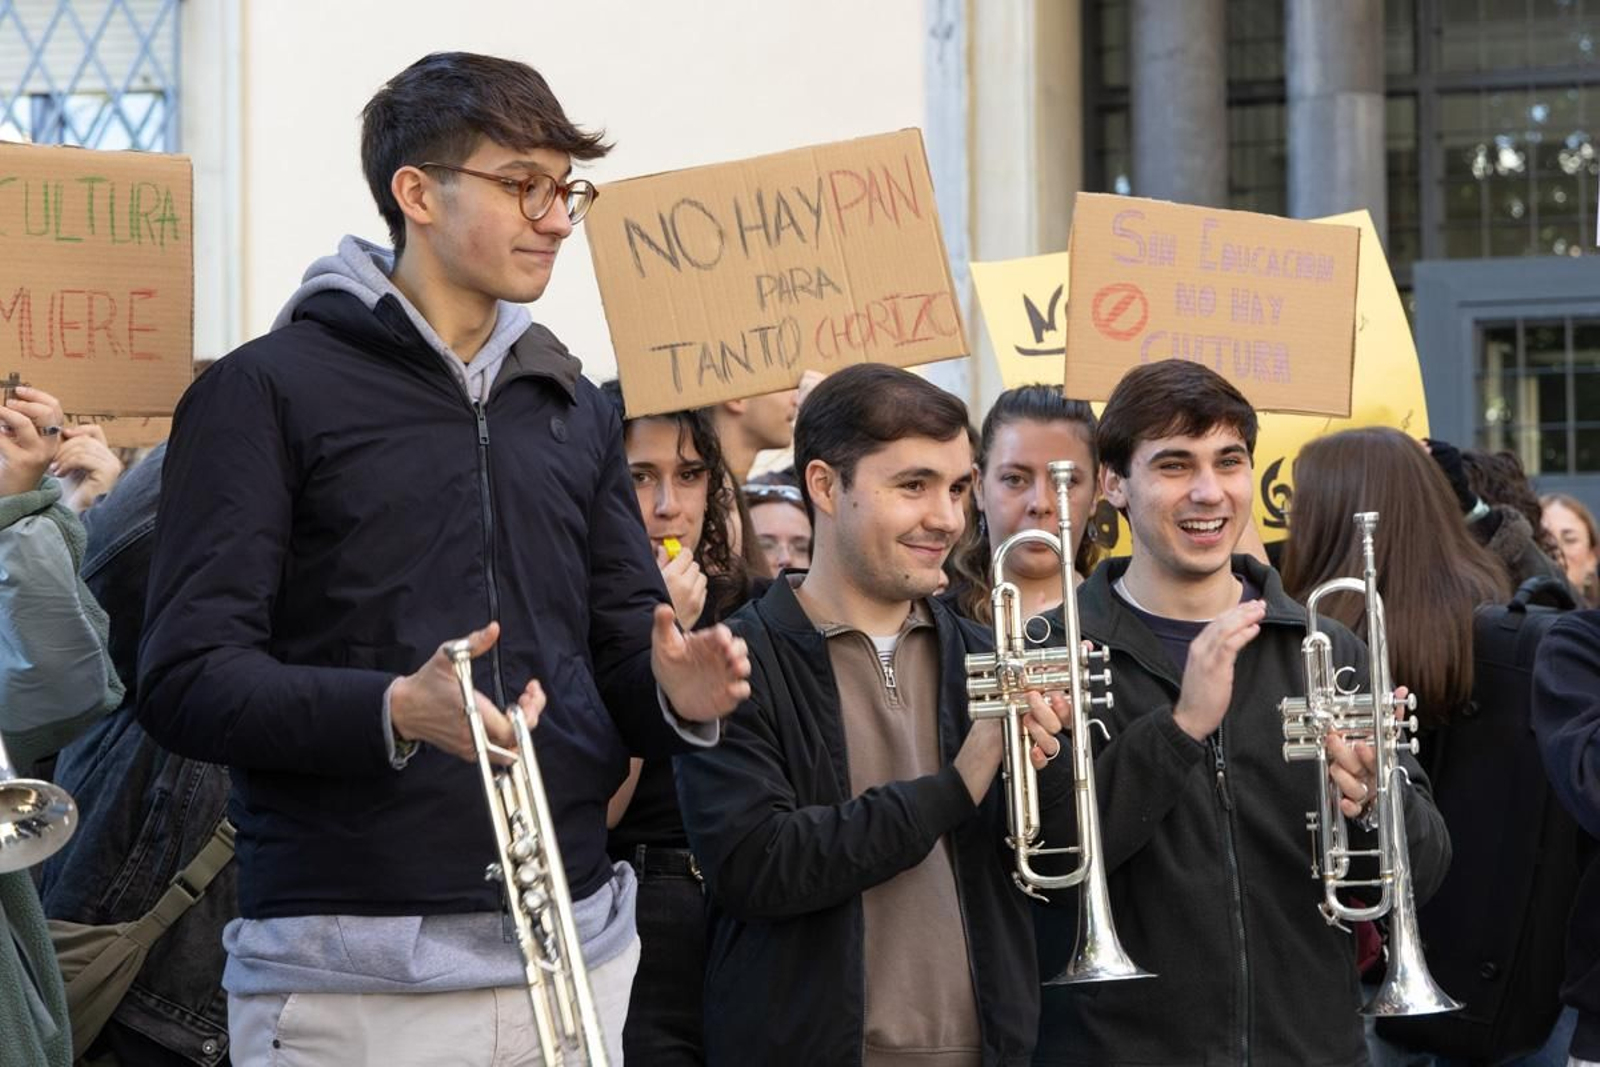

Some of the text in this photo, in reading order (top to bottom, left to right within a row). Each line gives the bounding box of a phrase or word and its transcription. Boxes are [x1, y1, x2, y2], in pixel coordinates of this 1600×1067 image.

[624, 154, 921, 278] NO HAY PAN
[0, 286, 163, 361] MUERE
[756, 267, 842, 311] PARA
[1175, 282, 1284, 326] NO HAY
[650, 317, 801, 395] TANTO
